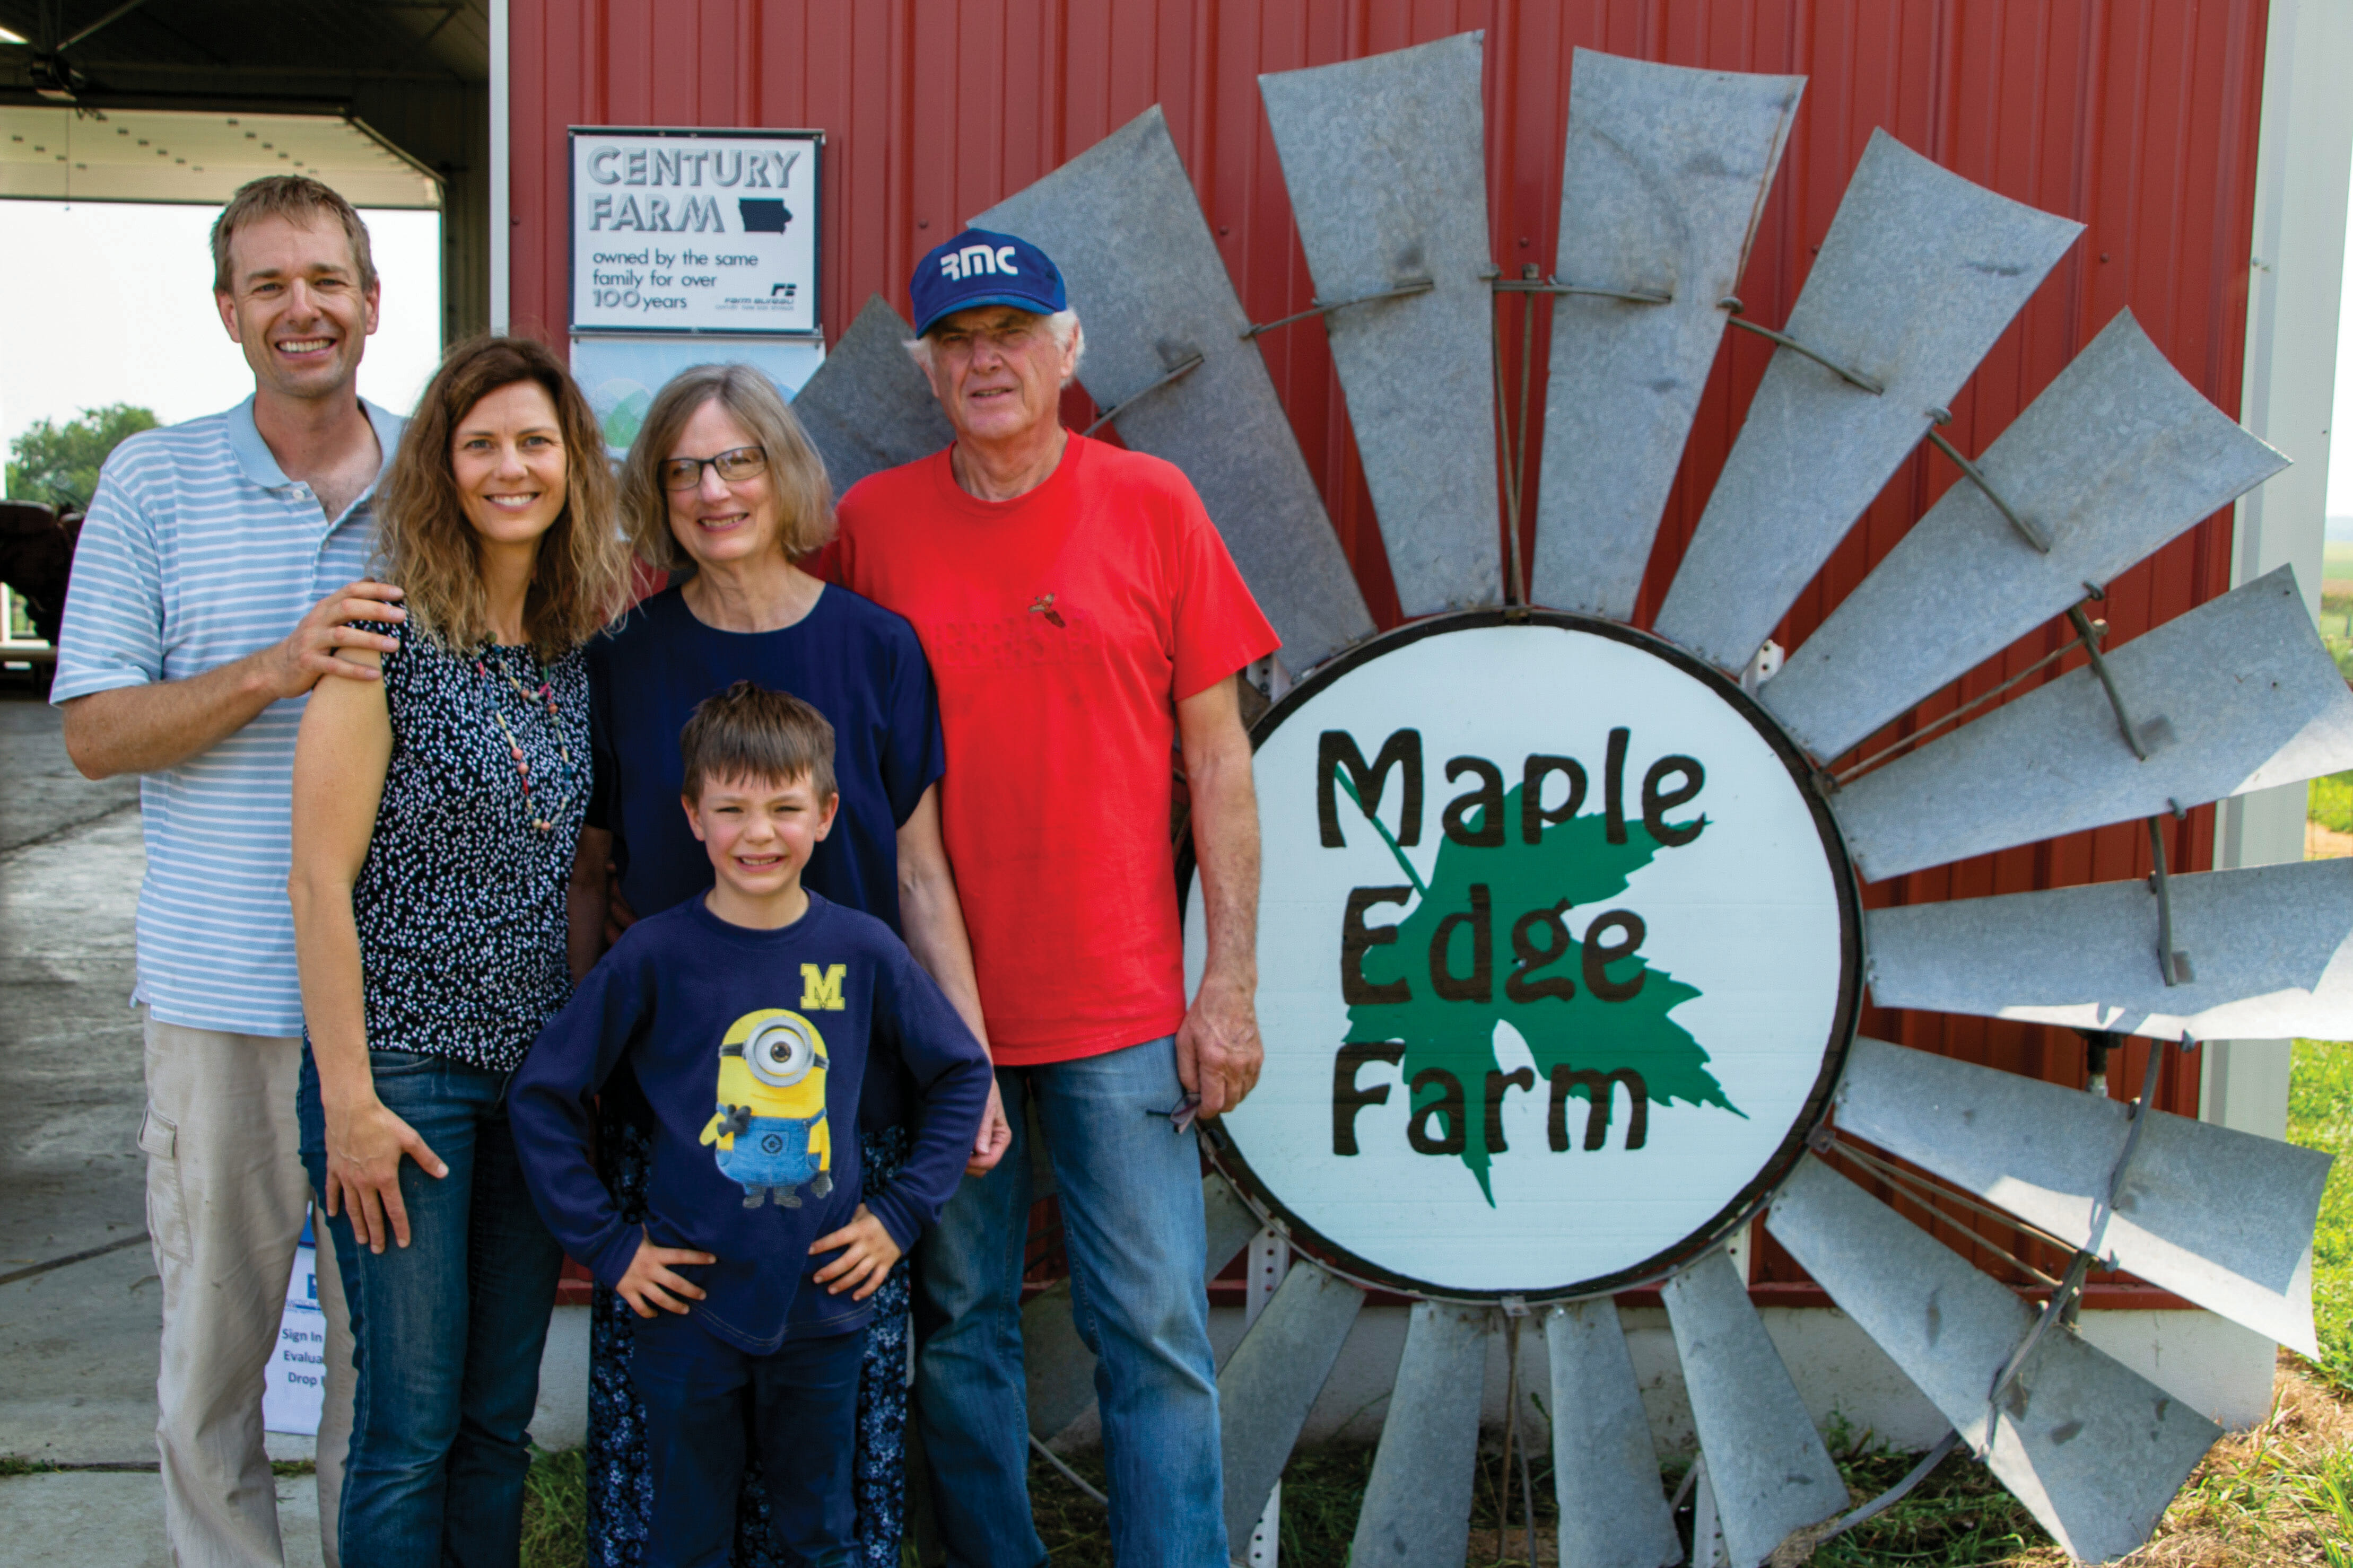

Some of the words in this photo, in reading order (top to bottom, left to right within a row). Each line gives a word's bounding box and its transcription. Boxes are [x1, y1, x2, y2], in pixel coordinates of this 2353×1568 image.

[587, 145, 800, 188] CENTURY
[588, 192, 725, 233] FARM
[592, 268, 644, 288] family
[650, 269, 673, 286] for
[681, 275, 717, 287] over
[593, 248, 649, 265] owned
[655, 248, 676, 269] by
[683, 248, 708, 266] the
[715, 255, 759, 266] same
[940, 244, 1018, 281] RMC
[592, 289, 641, 308] 100
[643, 296, 687, 312] years
[1317, 726, 1706, 847] Maple
[1340, 883, 1647, 1005] Edge
[800, 963, 847, 1010] M
[1332, 1041, 1648, 1155] Farm
[282, 1328, 308, 1343] Sign
[311, 1331, 323, 1342] In
[288, 1371, 318, 1387] Drop
